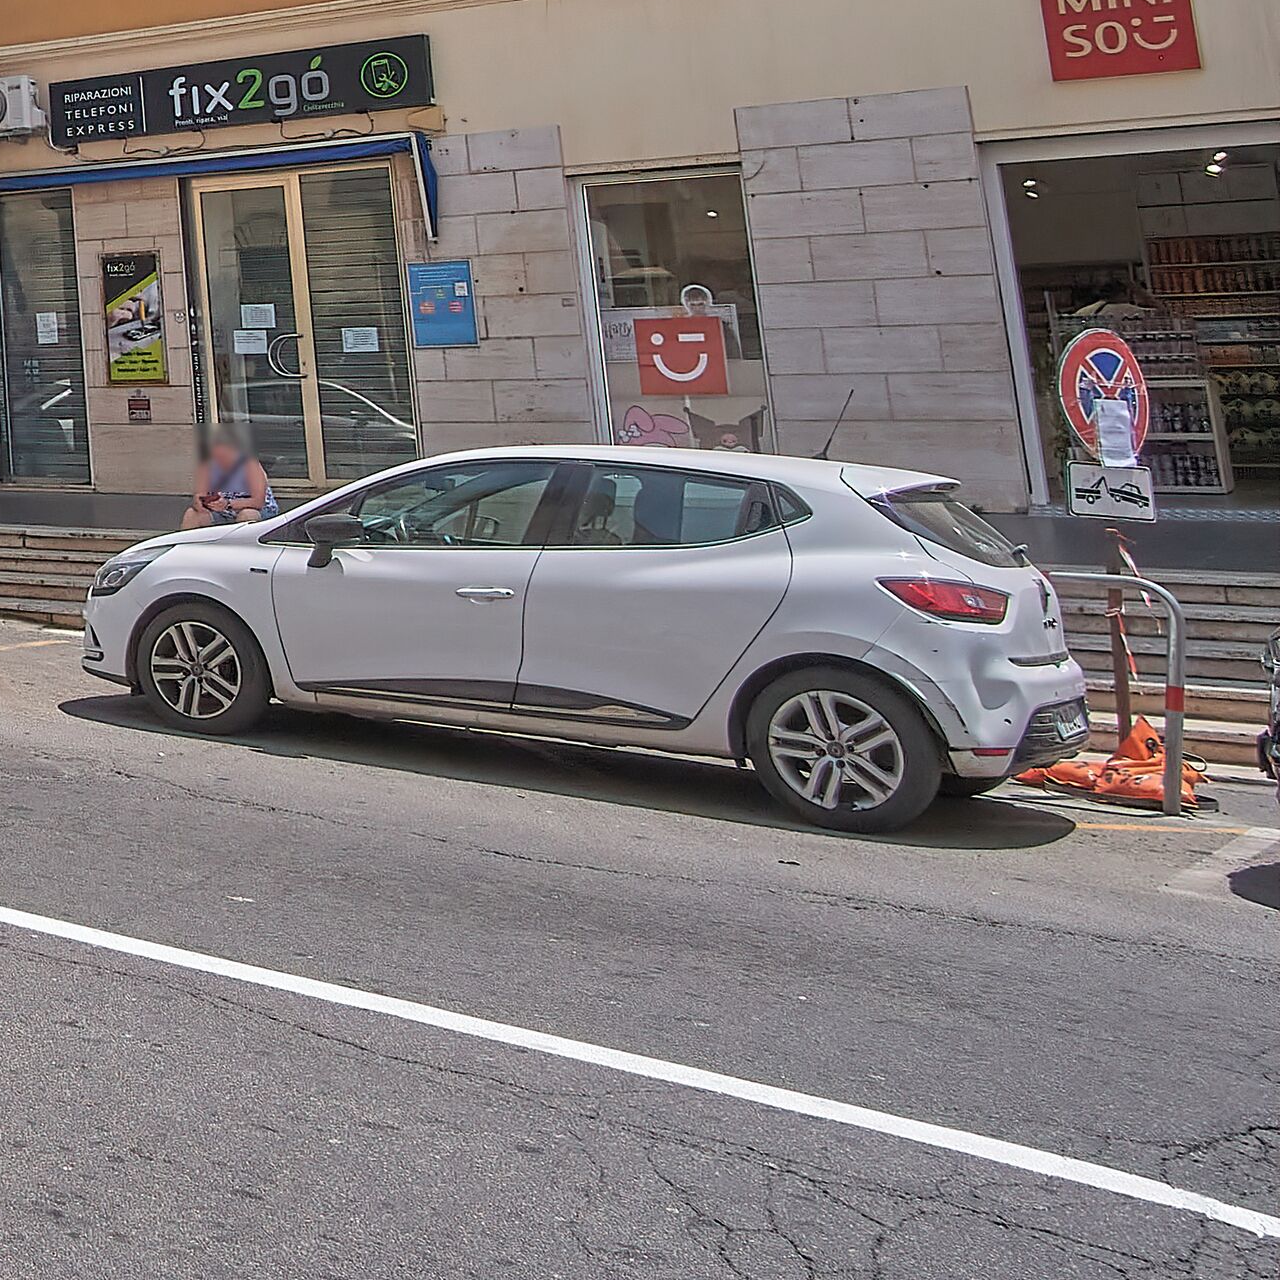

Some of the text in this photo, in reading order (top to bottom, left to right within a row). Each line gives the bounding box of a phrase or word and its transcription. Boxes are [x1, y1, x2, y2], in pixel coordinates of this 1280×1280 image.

[64, 86, 132, 103] RIPARAZIONI
[65, 103, 133, 120] TELEFONI
[66, 120, 135, 137] EXPRESS
